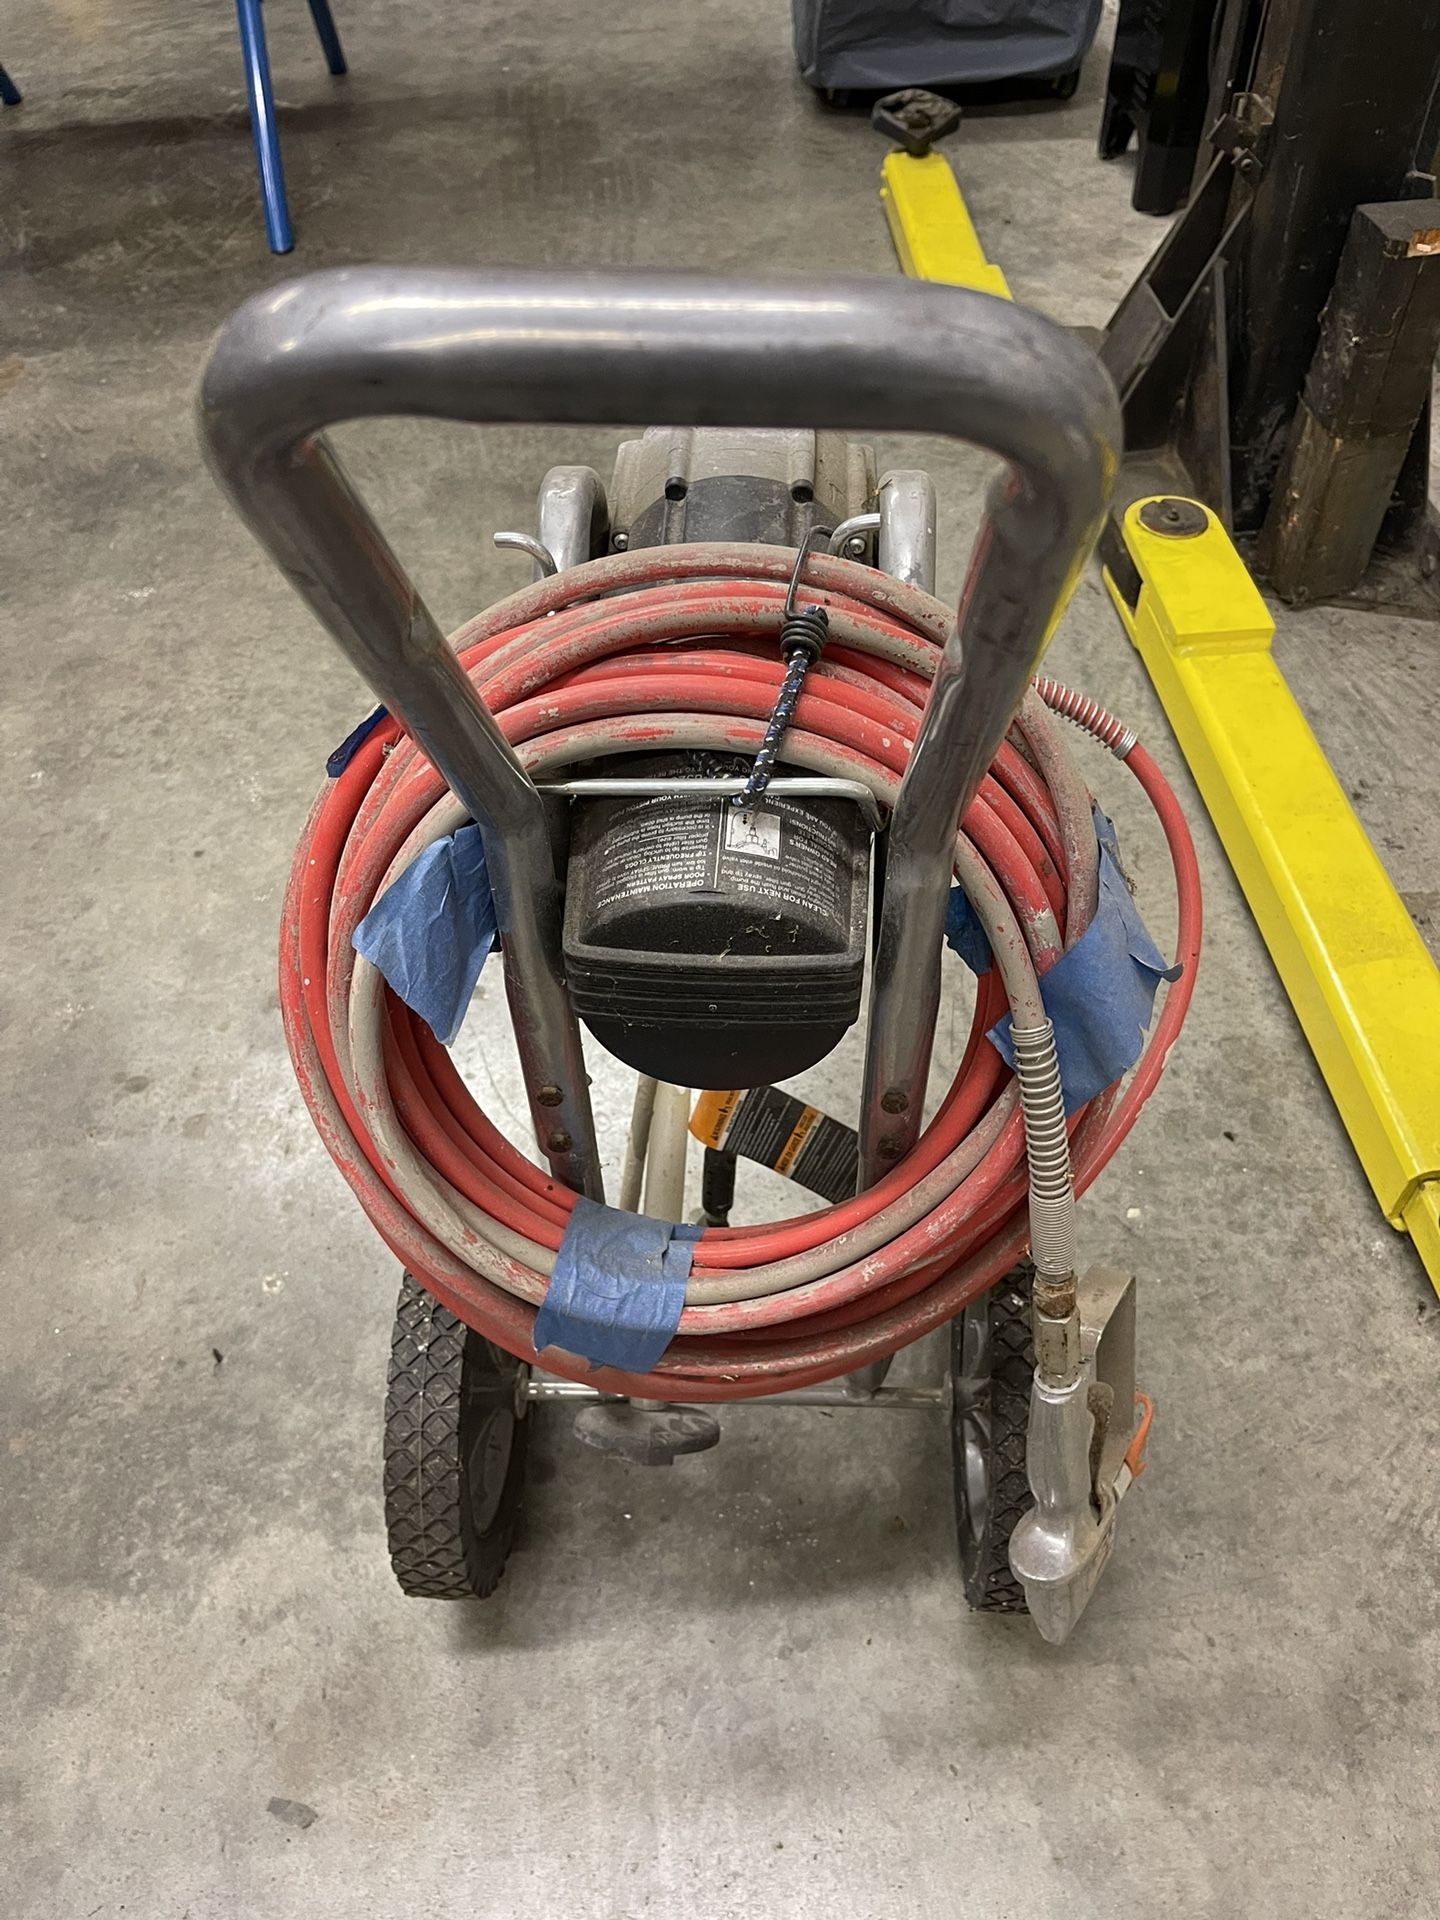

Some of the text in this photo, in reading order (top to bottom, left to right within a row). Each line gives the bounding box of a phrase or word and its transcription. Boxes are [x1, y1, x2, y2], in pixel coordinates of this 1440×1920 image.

[651, 795, 672, 804] YOUR
[764, 797, 804, 816] EXPERIENC
[662, 820, 684, 828] suction
[666, 824, 697, 832] necessary
[688, 831, 709, 839] proper
[793, 834, 808, 846] FOR
[647, 852, 694, 863] FREQUENTLY
[624, 858, 647, 870] CLOGS
[754, 861, 773, 869] inside
[626, 871, 705, 888] POOR SPRAY PATTERN
[734, 870, 743, 878] tip
[744, 871, 762, 880] spray
[737, 883, 756, 893] USE
[757, 886, 781, 898] NEXT
[596, 879, 704, 910] OPERATION MAINTENANCE
[782, 892, 800, 905] FOR
[801, 899, 828, 917] CLEAN
